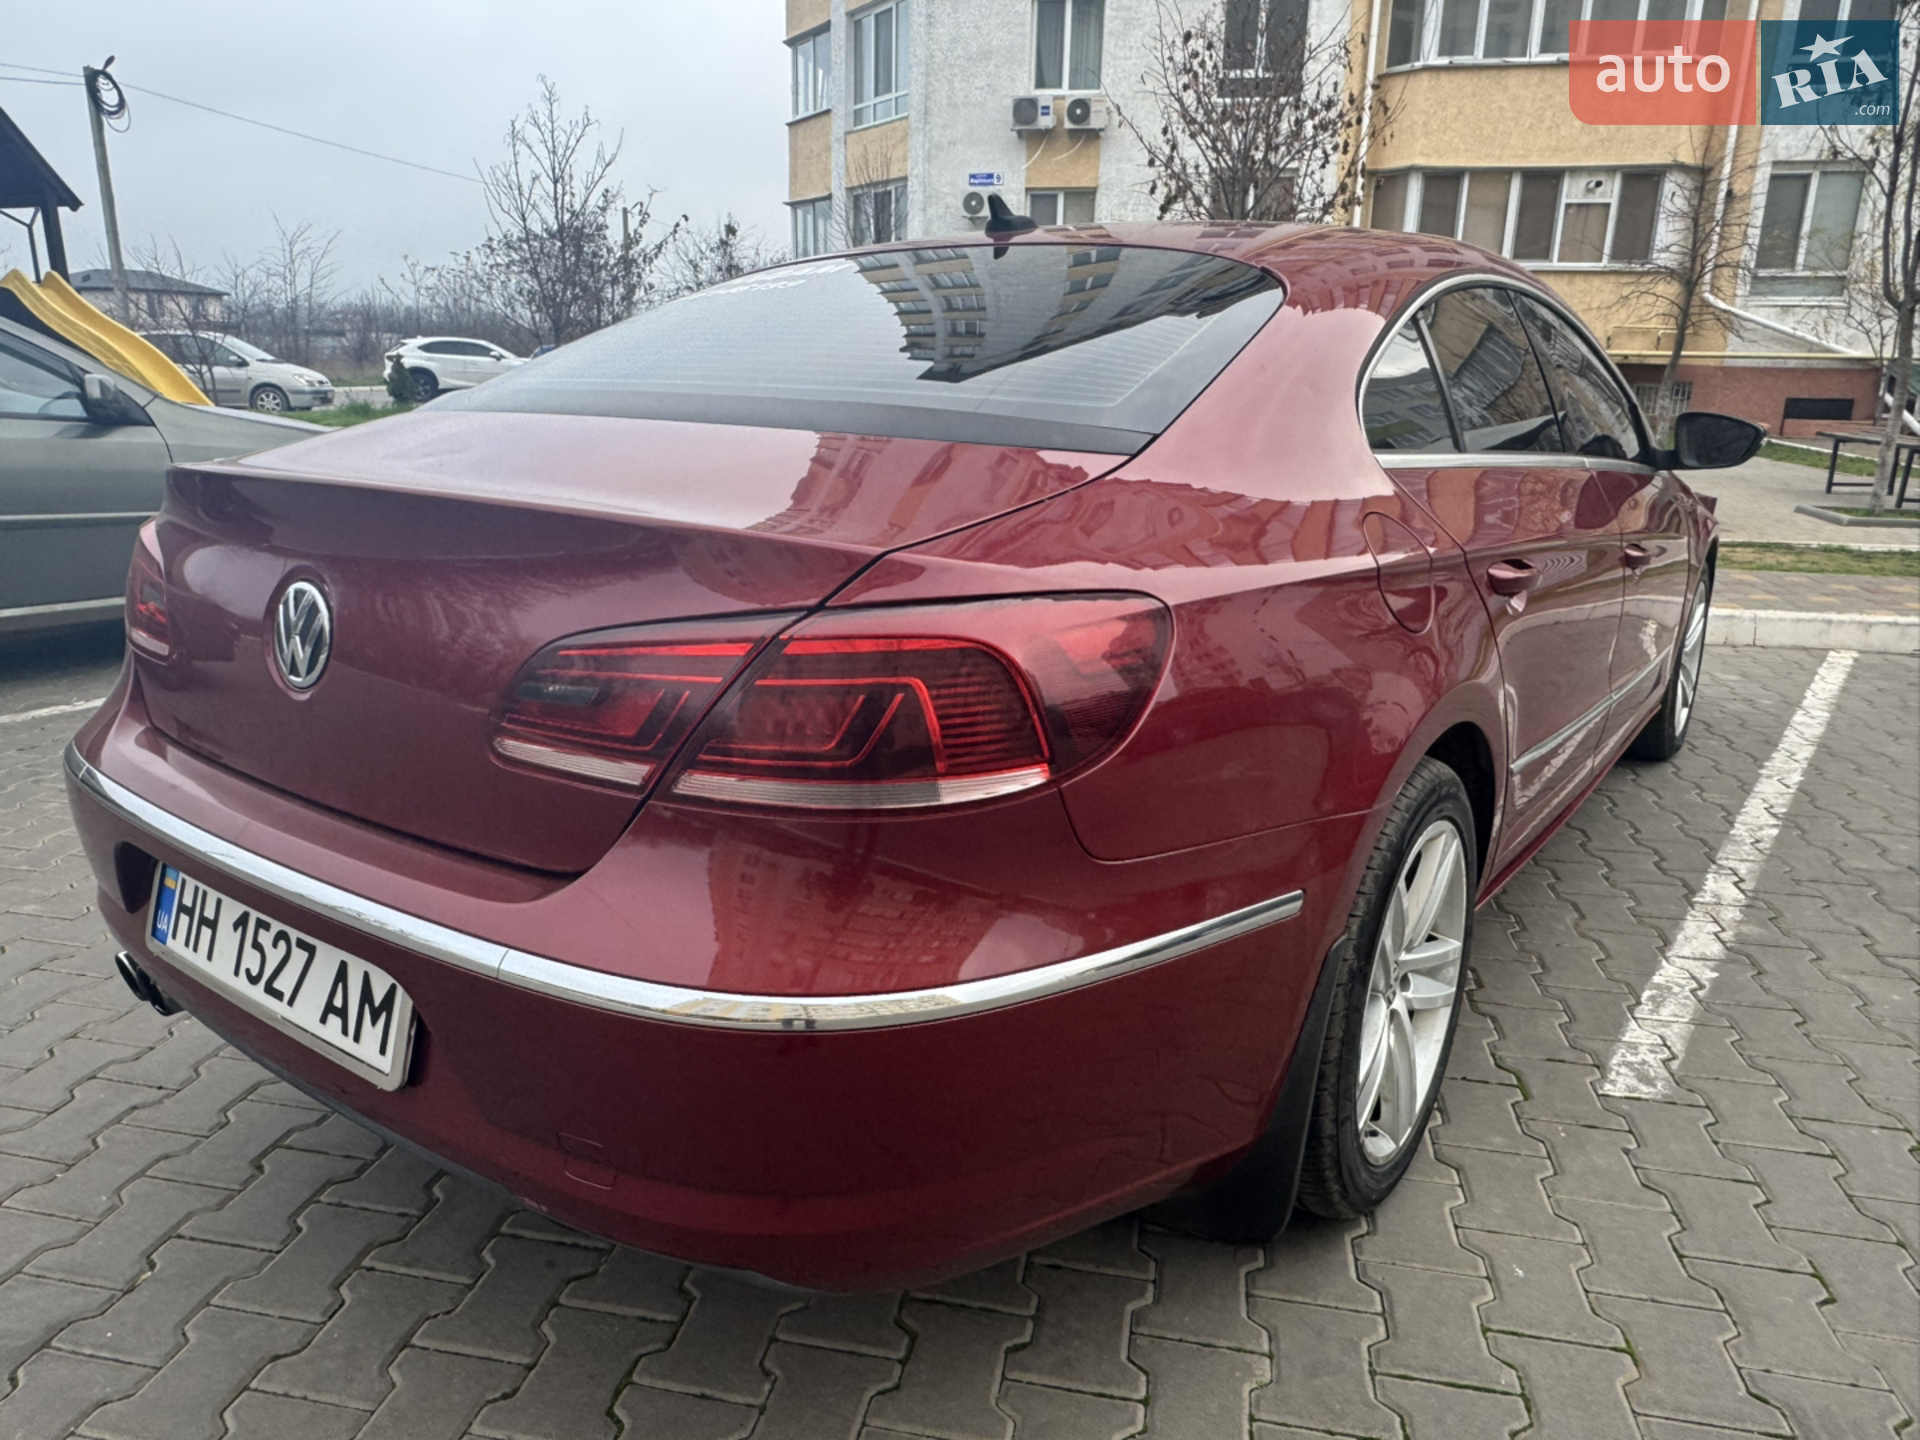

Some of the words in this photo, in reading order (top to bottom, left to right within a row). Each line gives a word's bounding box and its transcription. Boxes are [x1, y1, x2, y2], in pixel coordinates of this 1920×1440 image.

[156, 909, 169, 934] UA
[171, 876, 223, 963] HH
[232, 910, 317, 1008] 1527
[319, 959, 397, 1056] AM
